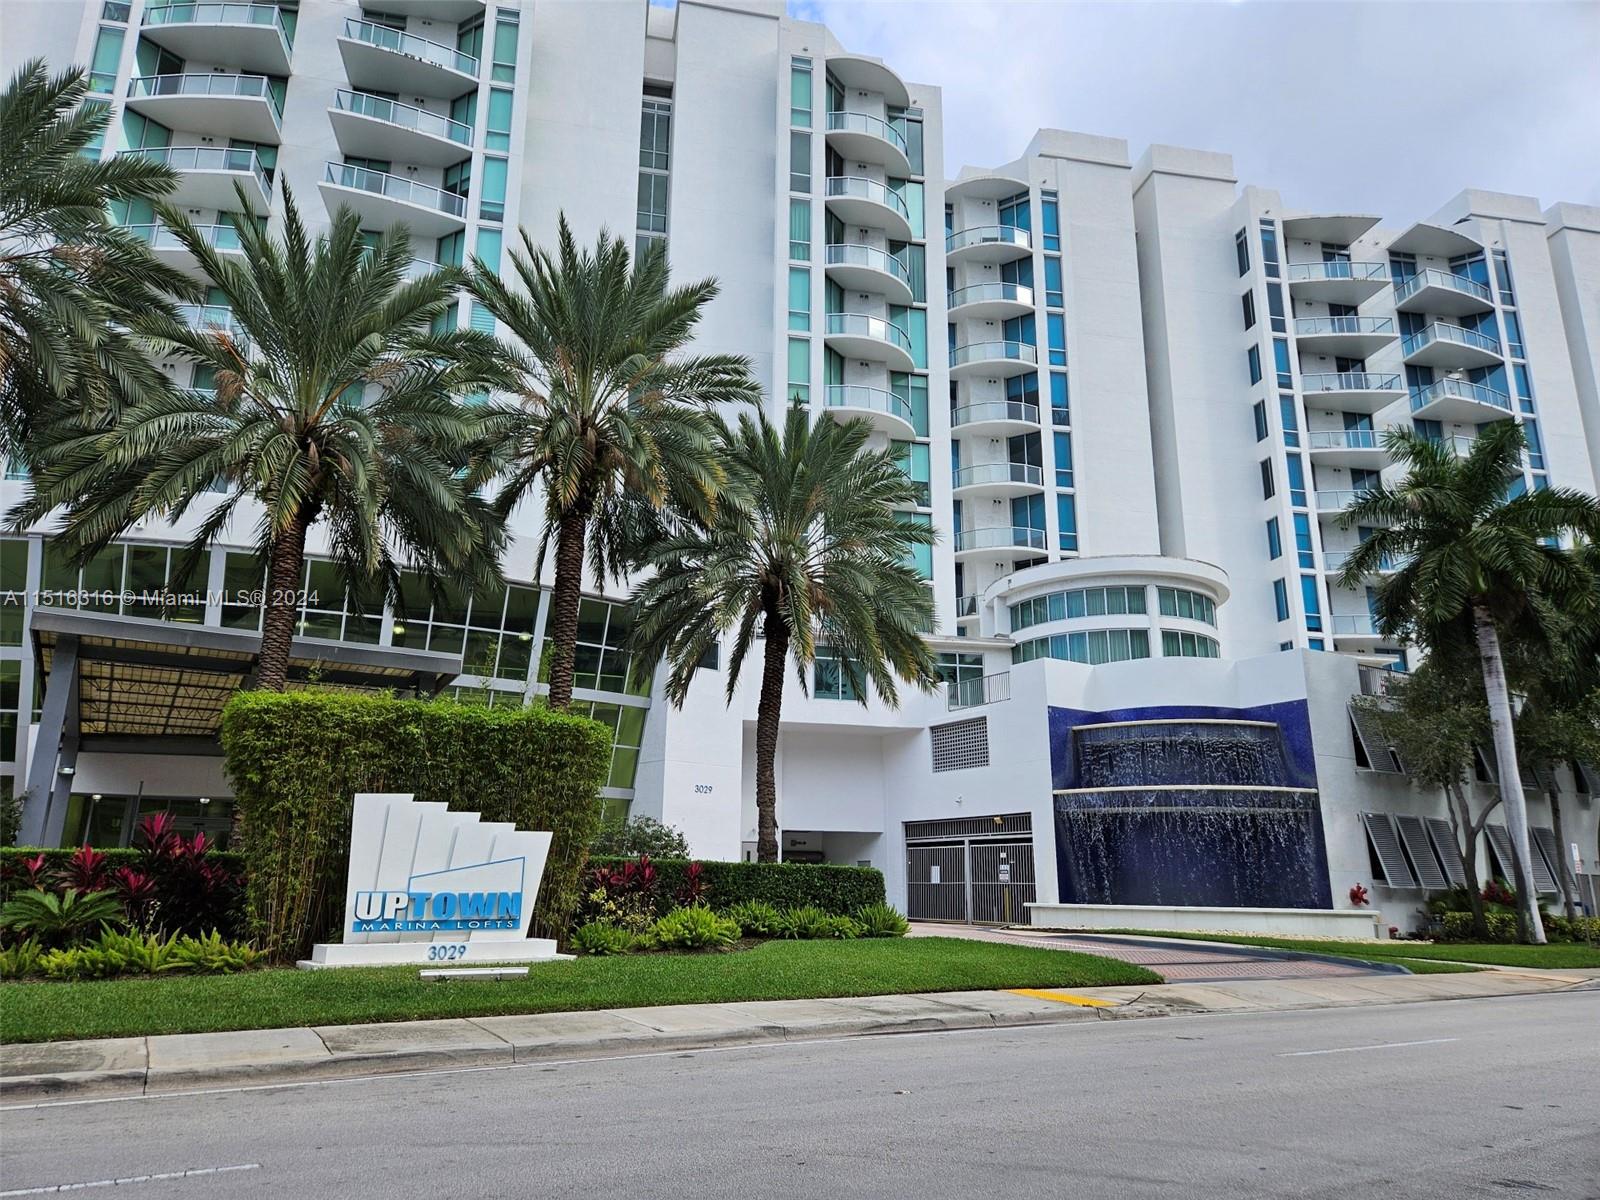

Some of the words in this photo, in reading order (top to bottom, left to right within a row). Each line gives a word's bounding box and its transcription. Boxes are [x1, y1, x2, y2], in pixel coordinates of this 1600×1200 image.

[694, 784, 713, 793] 3029
[355, 891, 522, 921] UPTOWN
[361, 921, 440, 931] MARINA
[457, 920, 513, 929] LOFTS
[428, 945, 467, 960] 3029
